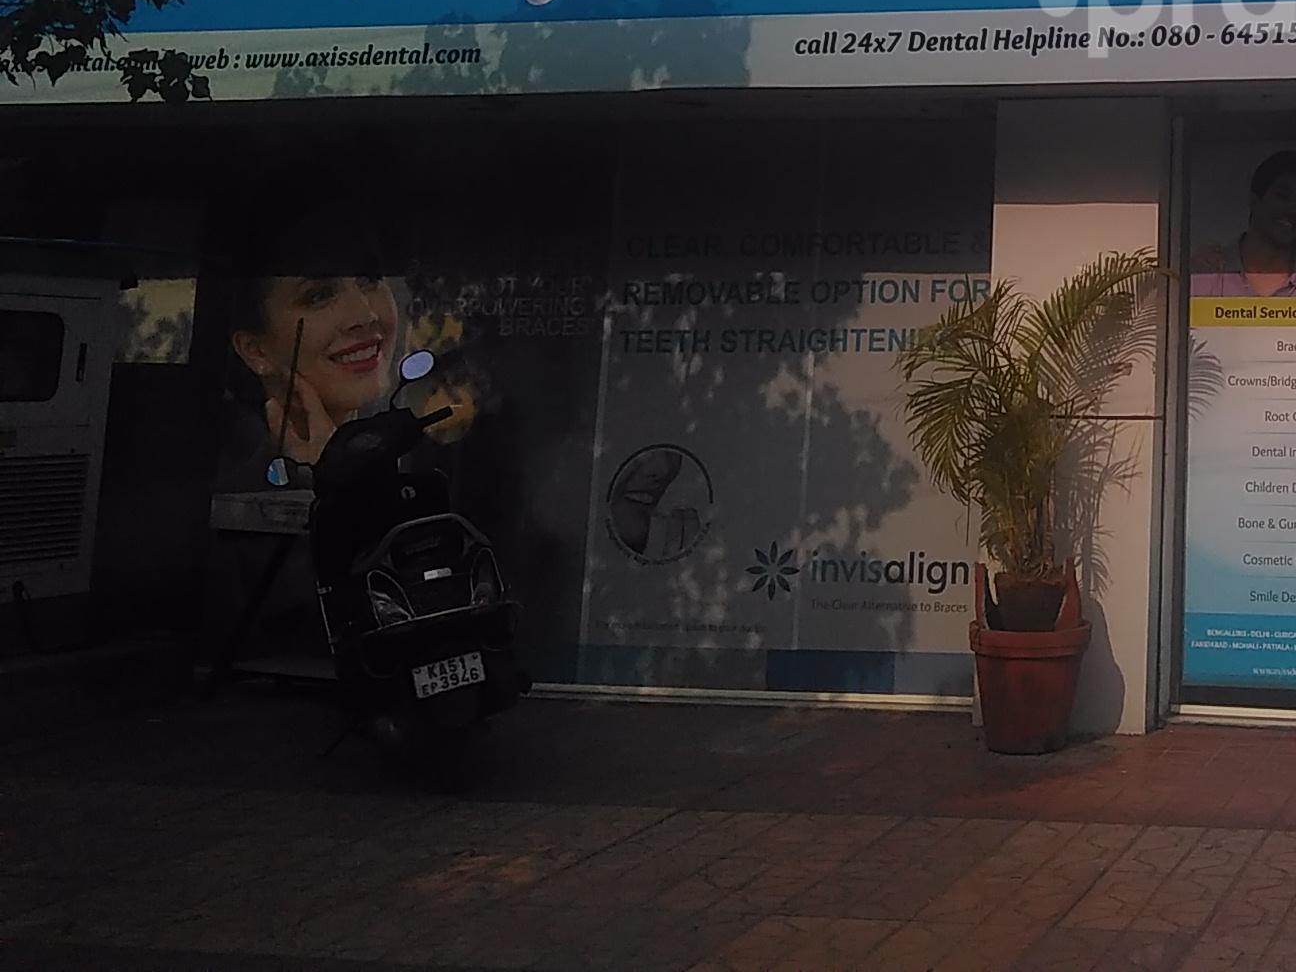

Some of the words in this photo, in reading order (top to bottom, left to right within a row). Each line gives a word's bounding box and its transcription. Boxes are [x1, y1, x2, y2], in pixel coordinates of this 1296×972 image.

[794, 31, 837, 54] call
[841, 31, 901, 54] 24x7
[907, 27, 988, 52] Dental
[993, 27, 1091, 57] Helpline
[1151, 24, 1201, 47] 080
[245, 44, 481, 70] www.axissdental.com
[622, 280, 801, 306] REMOVABLE
[811, 278, 920, 305] OPTION
[929, 278, 991, 304] FOR
[1215, 307, 1256, 319] Dental
[620, 330, 711, 354] TEETH
[1265, 411, 1289, 422] Root
[1252, 447, 1286, 458] Dental
[1245, 482, 1289, 493] Children
[1238, 518, 1265, 529] Bone
[1268, 519, 1275, 529] &
[1243, 554, 1293, 566] Cosmetic
[811, 552, 969, 594] invisalign
[1250, 591, 1278, 602] Smile
[934, 602, 968, 614] Braces
